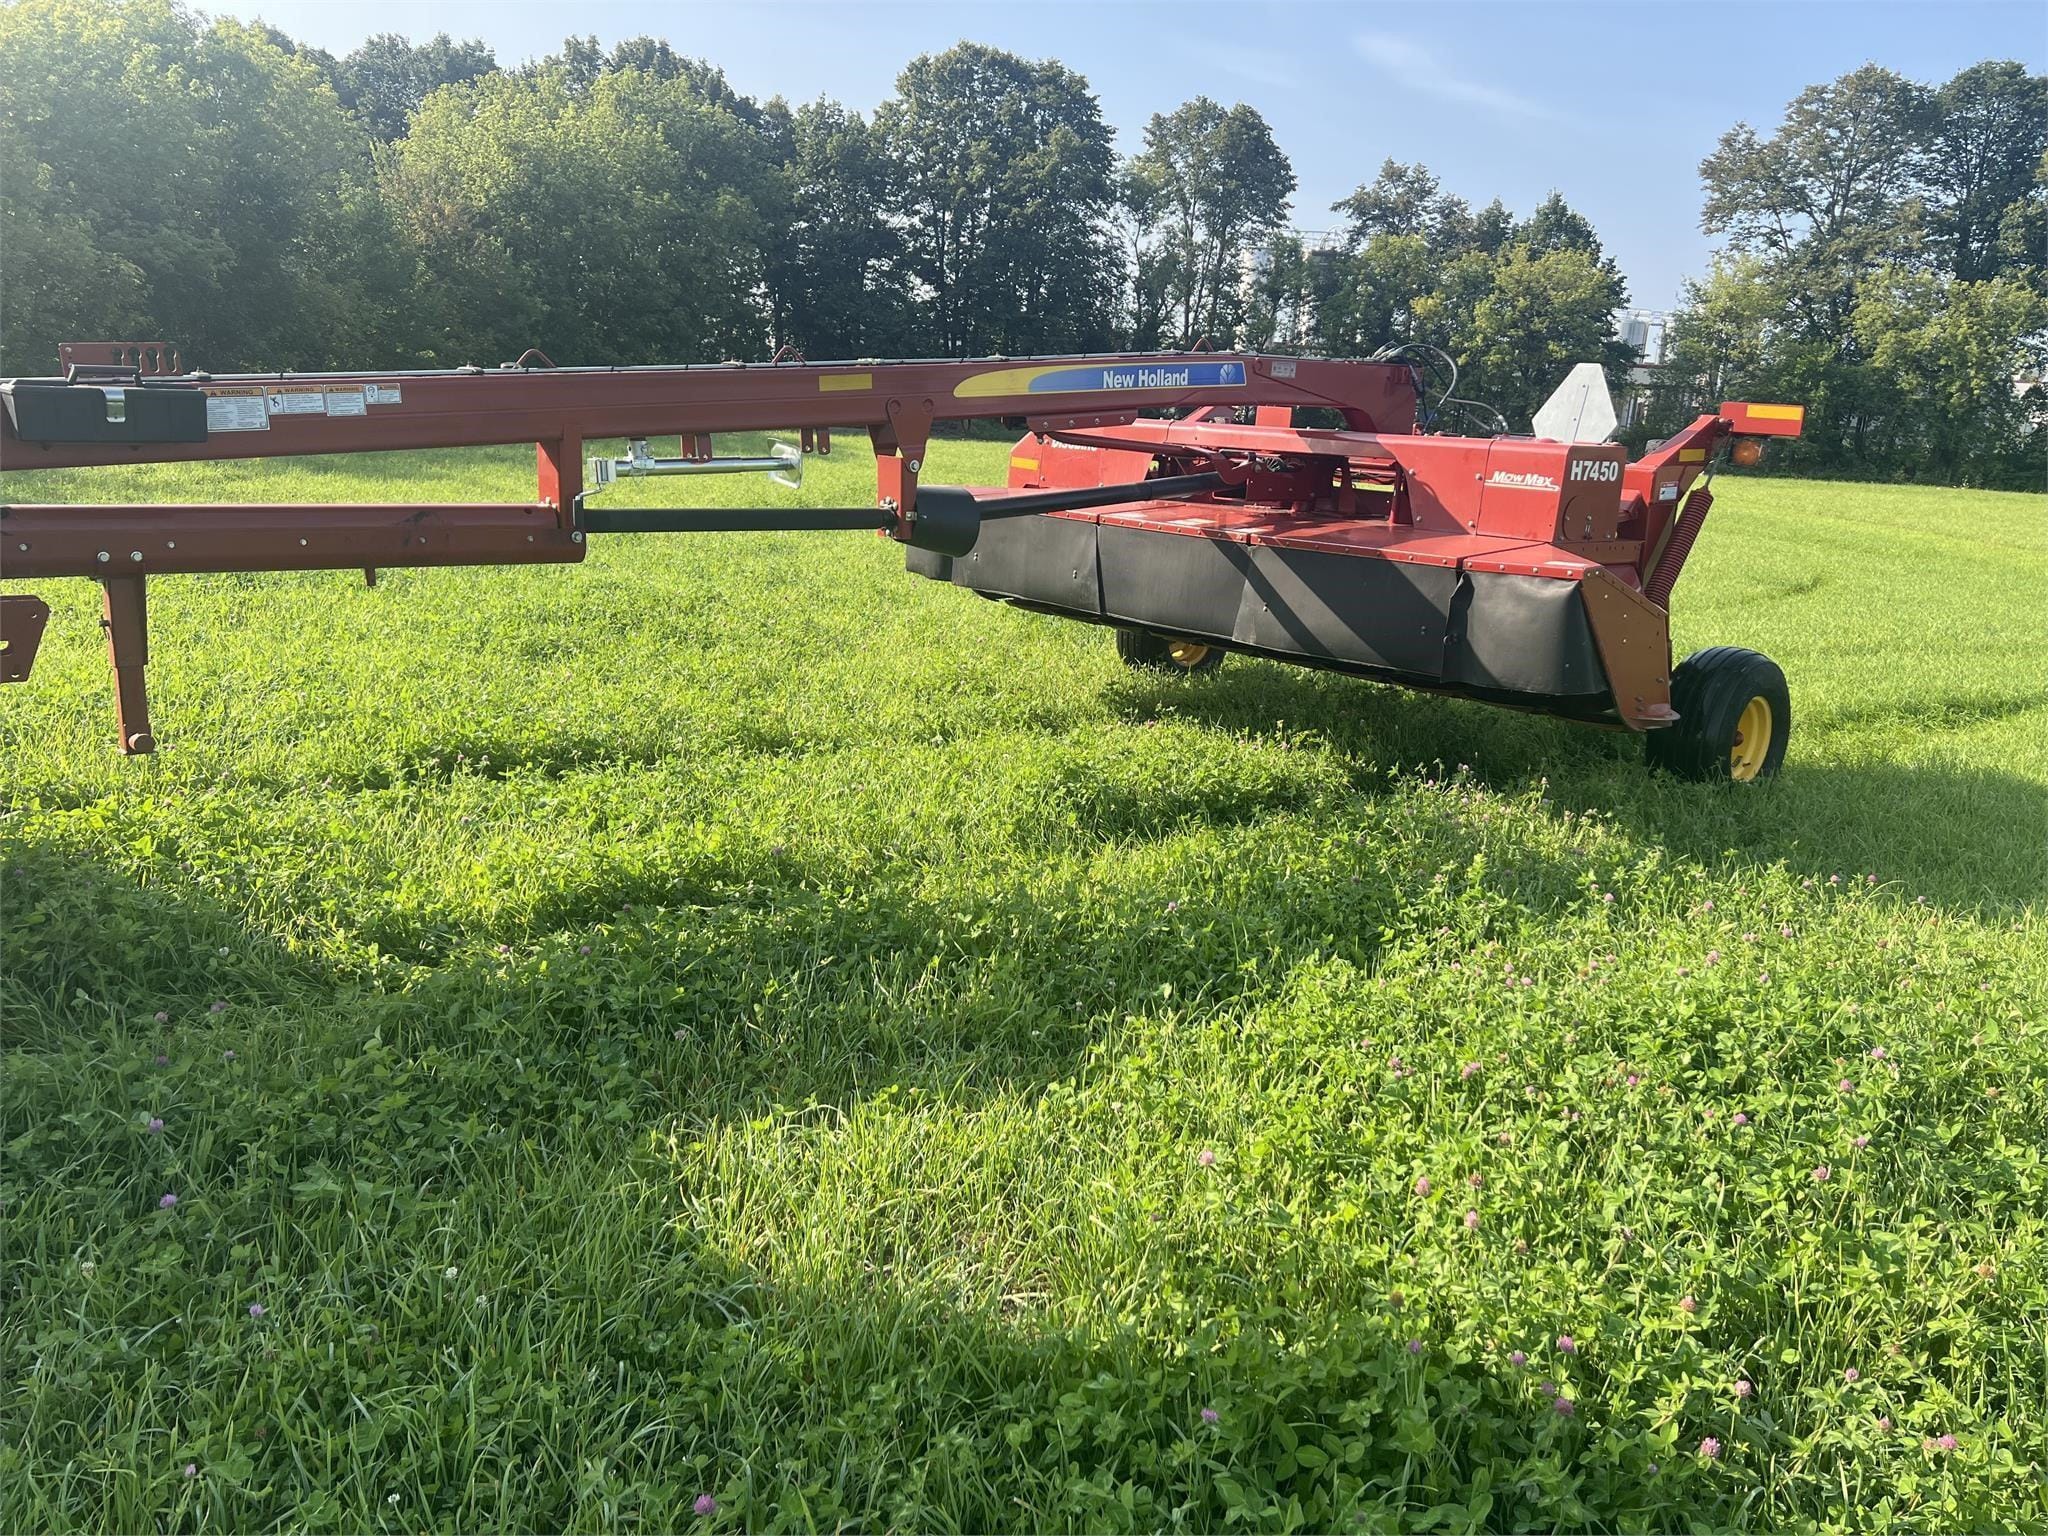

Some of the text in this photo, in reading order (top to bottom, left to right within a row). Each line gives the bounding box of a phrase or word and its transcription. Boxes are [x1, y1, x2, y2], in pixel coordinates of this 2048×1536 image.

[1103, 368, 1189, 389] New Holland
[1570, 460, 1619, 481] H7450
